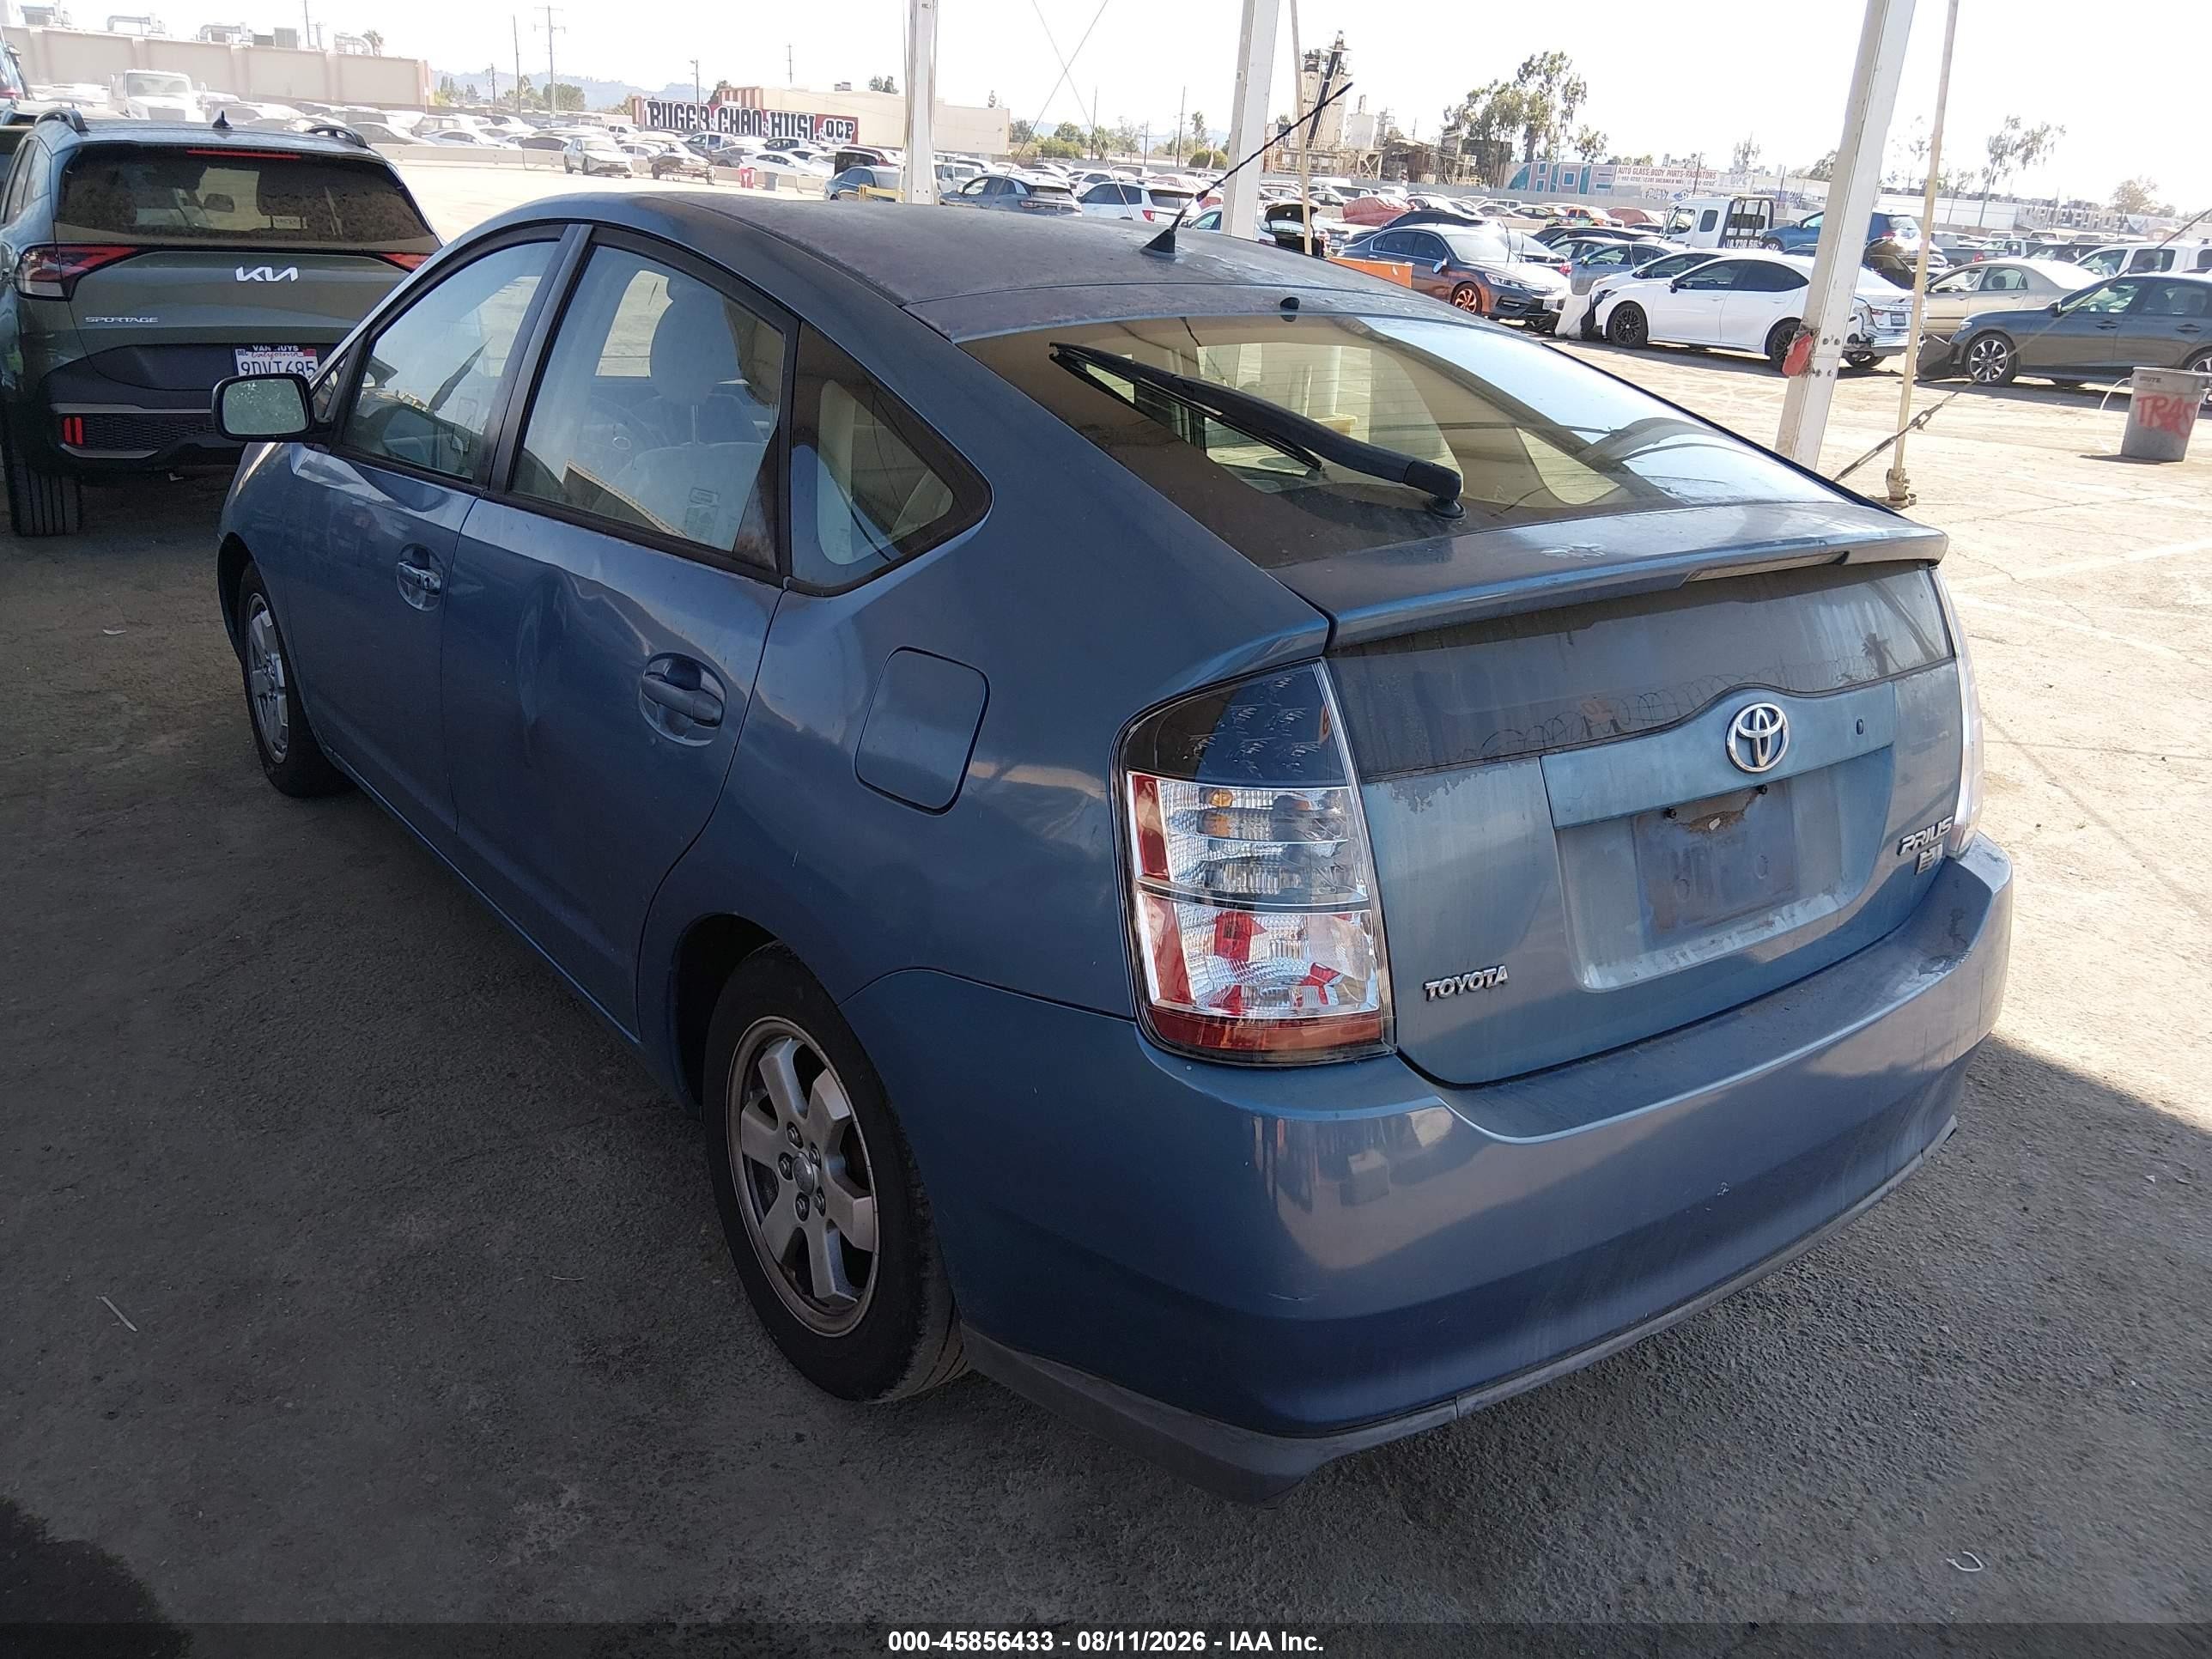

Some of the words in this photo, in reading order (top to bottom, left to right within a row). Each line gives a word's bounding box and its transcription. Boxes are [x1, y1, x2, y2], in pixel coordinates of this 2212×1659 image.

[235, 266, 298, 282] KIA
[1896, 814, 1954, 856] PRIUS
[1423, 963, 1509, 1002] TOYOTA
